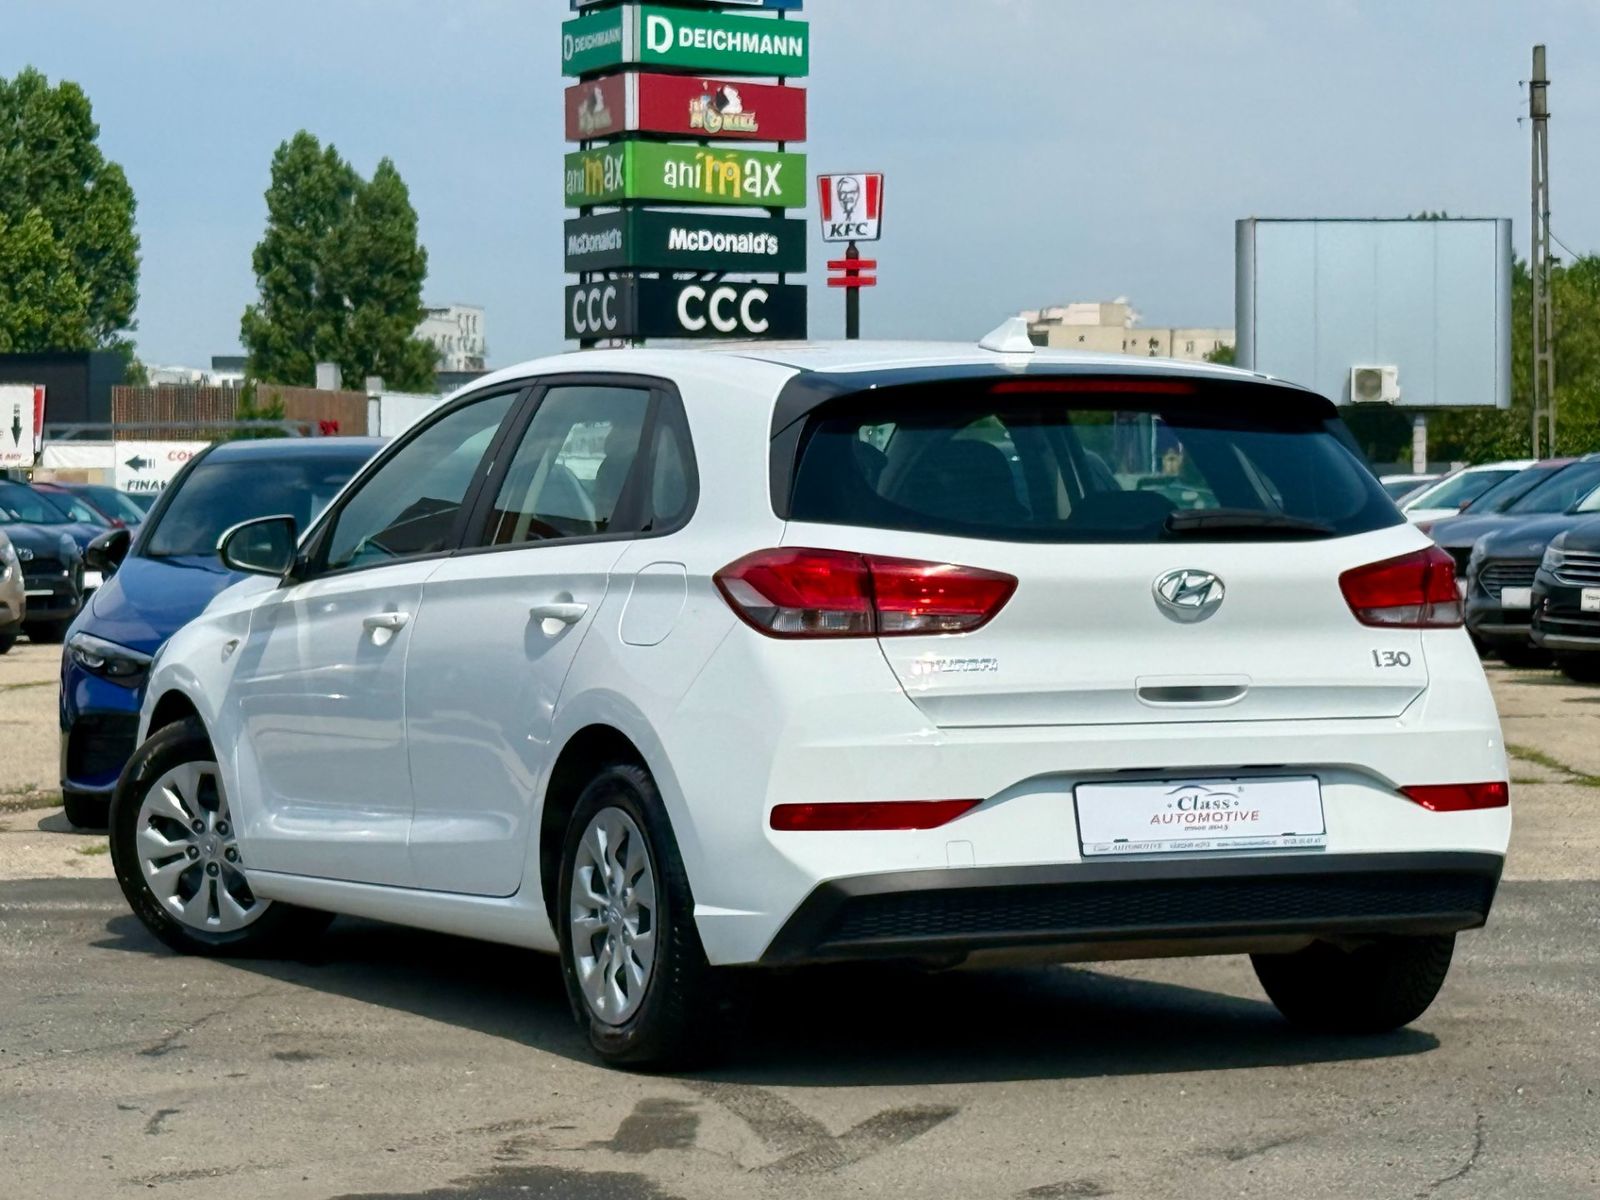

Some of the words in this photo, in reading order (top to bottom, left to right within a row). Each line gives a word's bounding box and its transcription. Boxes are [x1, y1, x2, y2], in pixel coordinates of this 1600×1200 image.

[646, 15, 674, 53] D
[678, 27, 803, 57] DEICHMANN
[663, 153, 783, 198] animax
[567, 229, 623, 256] McDonald's
[668, 227, 779, 256] McDonald's
[829, 222, 868, 238] KFC
[572, 286, 617, 334] CCC
[677, 285, 769, 333] CCC
[1150, 810, 1260, 825] AUTOMOTIVE
[1177, 794, 1231, 812] Class
